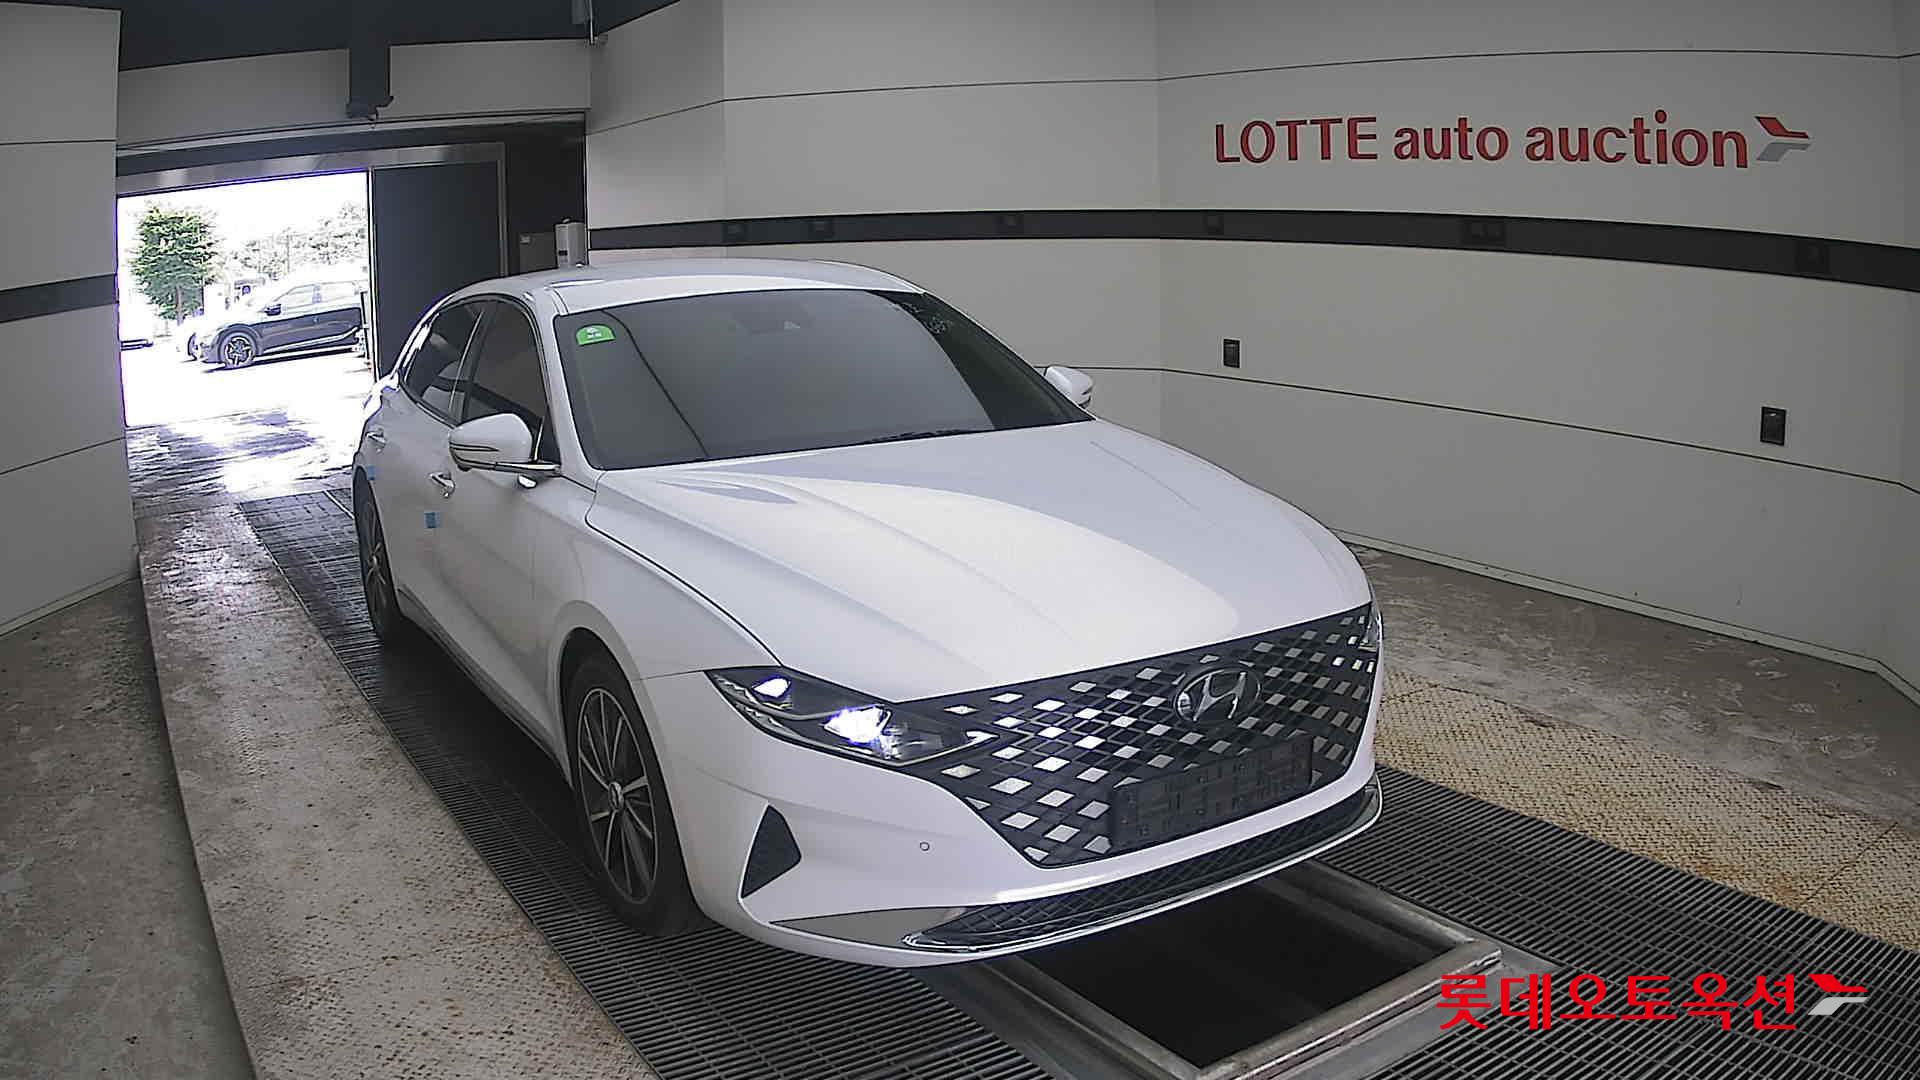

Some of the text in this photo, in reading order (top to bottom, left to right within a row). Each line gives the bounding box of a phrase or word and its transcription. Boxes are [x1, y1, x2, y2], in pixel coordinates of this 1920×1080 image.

[1215, 110, 1748, 169] LOTTE auto auction
